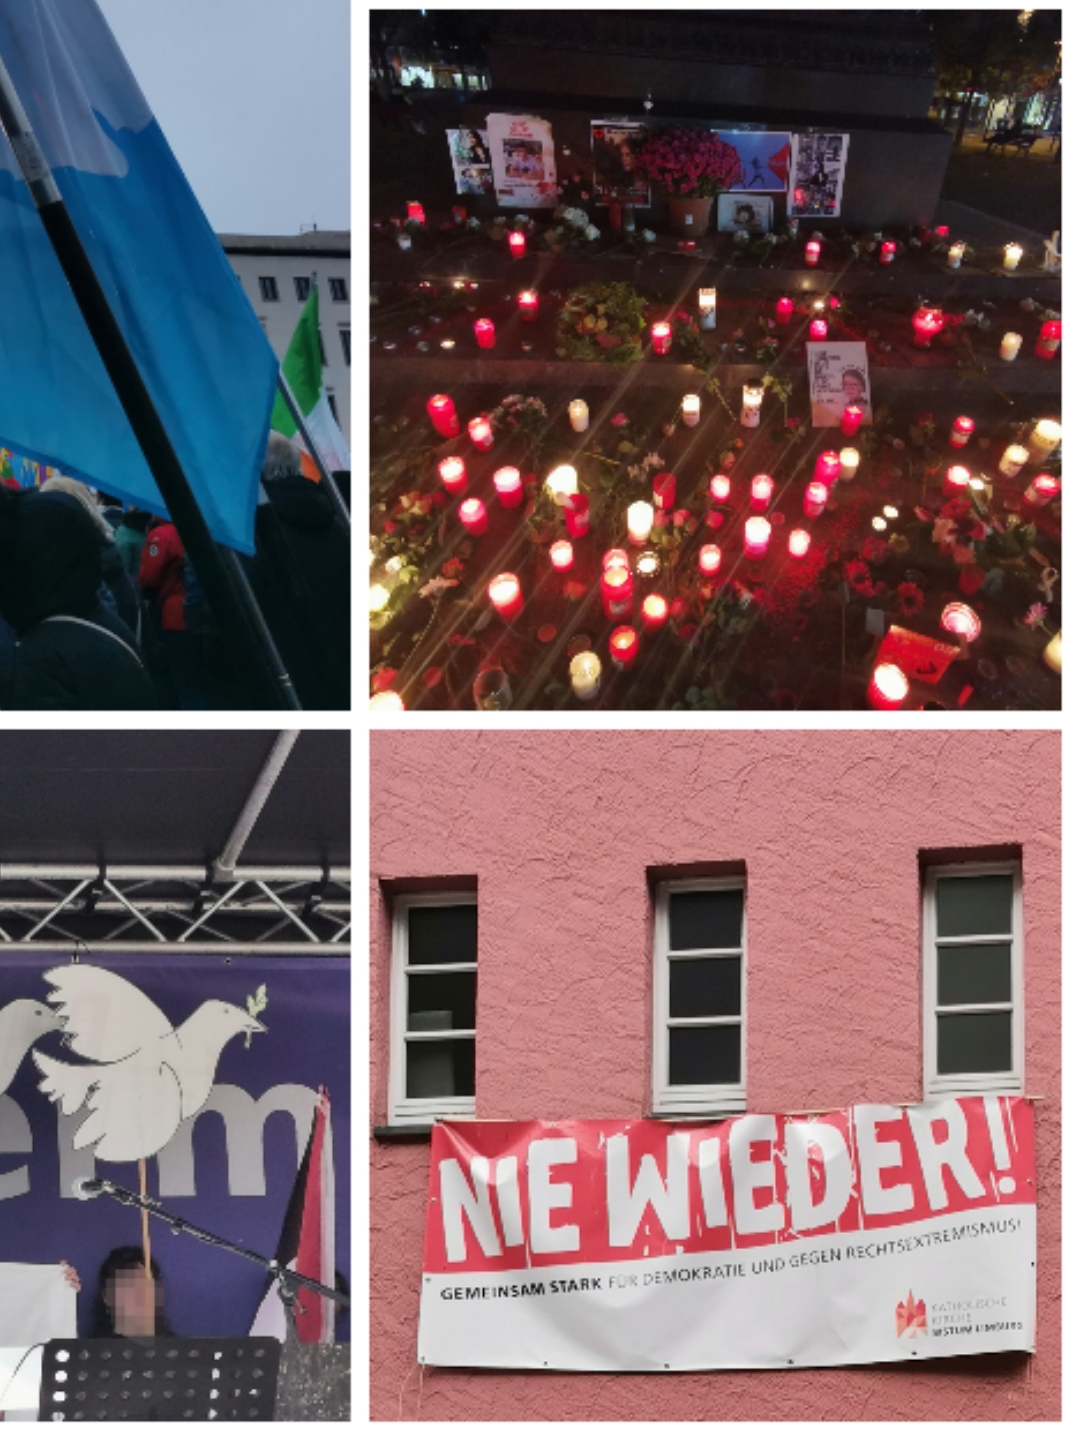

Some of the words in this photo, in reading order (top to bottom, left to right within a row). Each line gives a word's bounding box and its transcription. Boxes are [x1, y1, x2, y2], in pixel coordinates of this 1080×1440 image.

[439, 1136, 581, 1264] NIE
[606, 1095, 1016, 1250] WIEDER!
[440, 1279, 546, 1302] GEMEINSAM
[548, 1276, 602, 1294] STARK
[608, 1271, 639, 1290] FÜR
[642, 1262, 747, 1287] DEMOKRATIE
[750, 1256, 786, 1276] UND
[788, 1246, 842, 1269] GEGEN
[845, 1216, 1022, 1260] RECHTSEXTREMISMUS!
